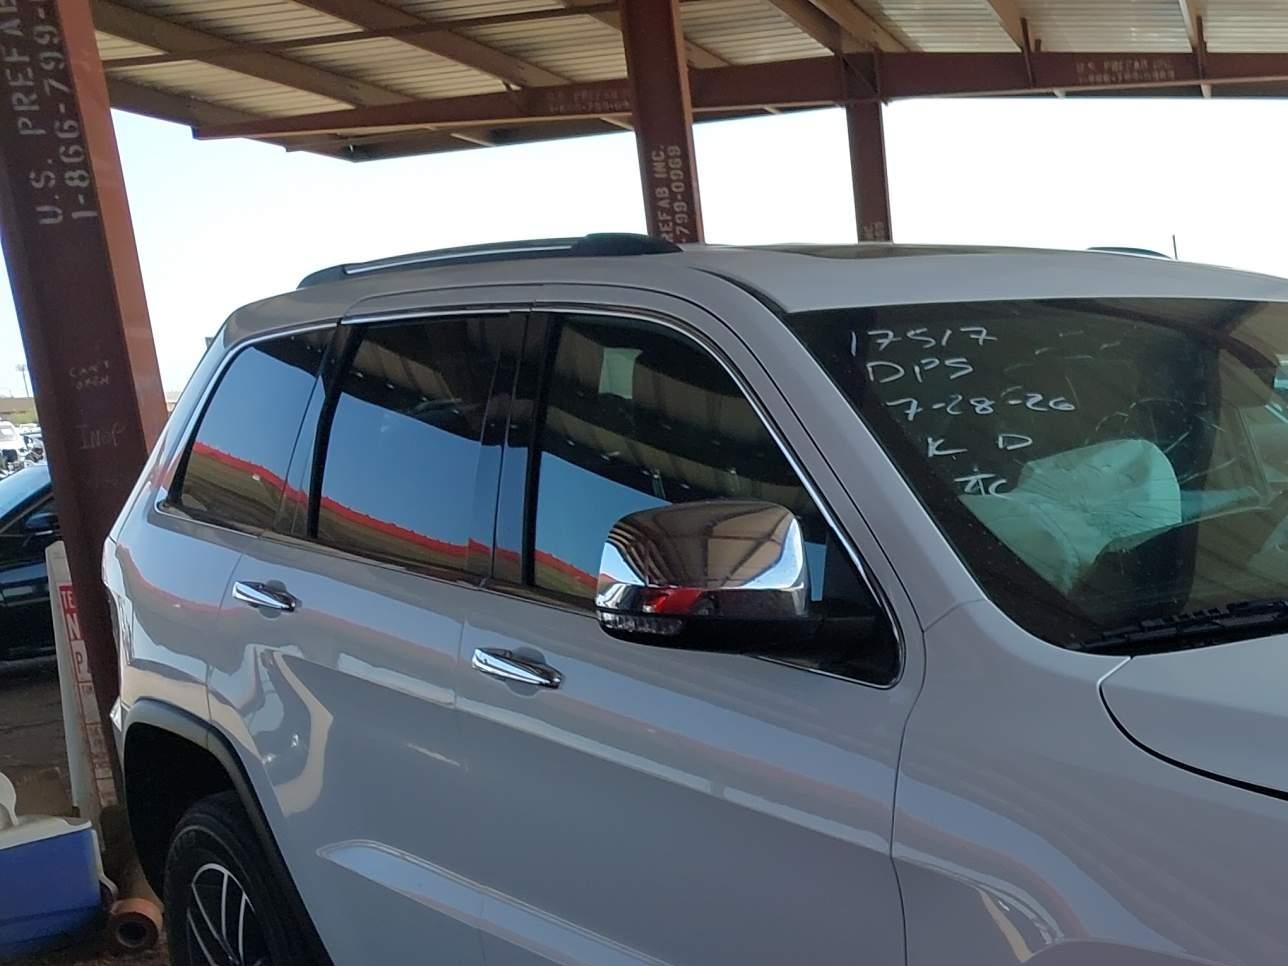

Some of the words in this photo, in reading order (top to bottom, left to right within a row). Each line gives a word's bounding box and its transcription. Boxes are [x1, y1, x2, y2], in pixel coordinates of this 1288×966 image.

[31, 0, 98, 220] 1-866-799-
[30, 158, 64, 224] U.S.
[850, 327, 998, 357] 17517
[866, 358, 974, 383] DPS
[885, 393, 1076, 421] 7-28-26
